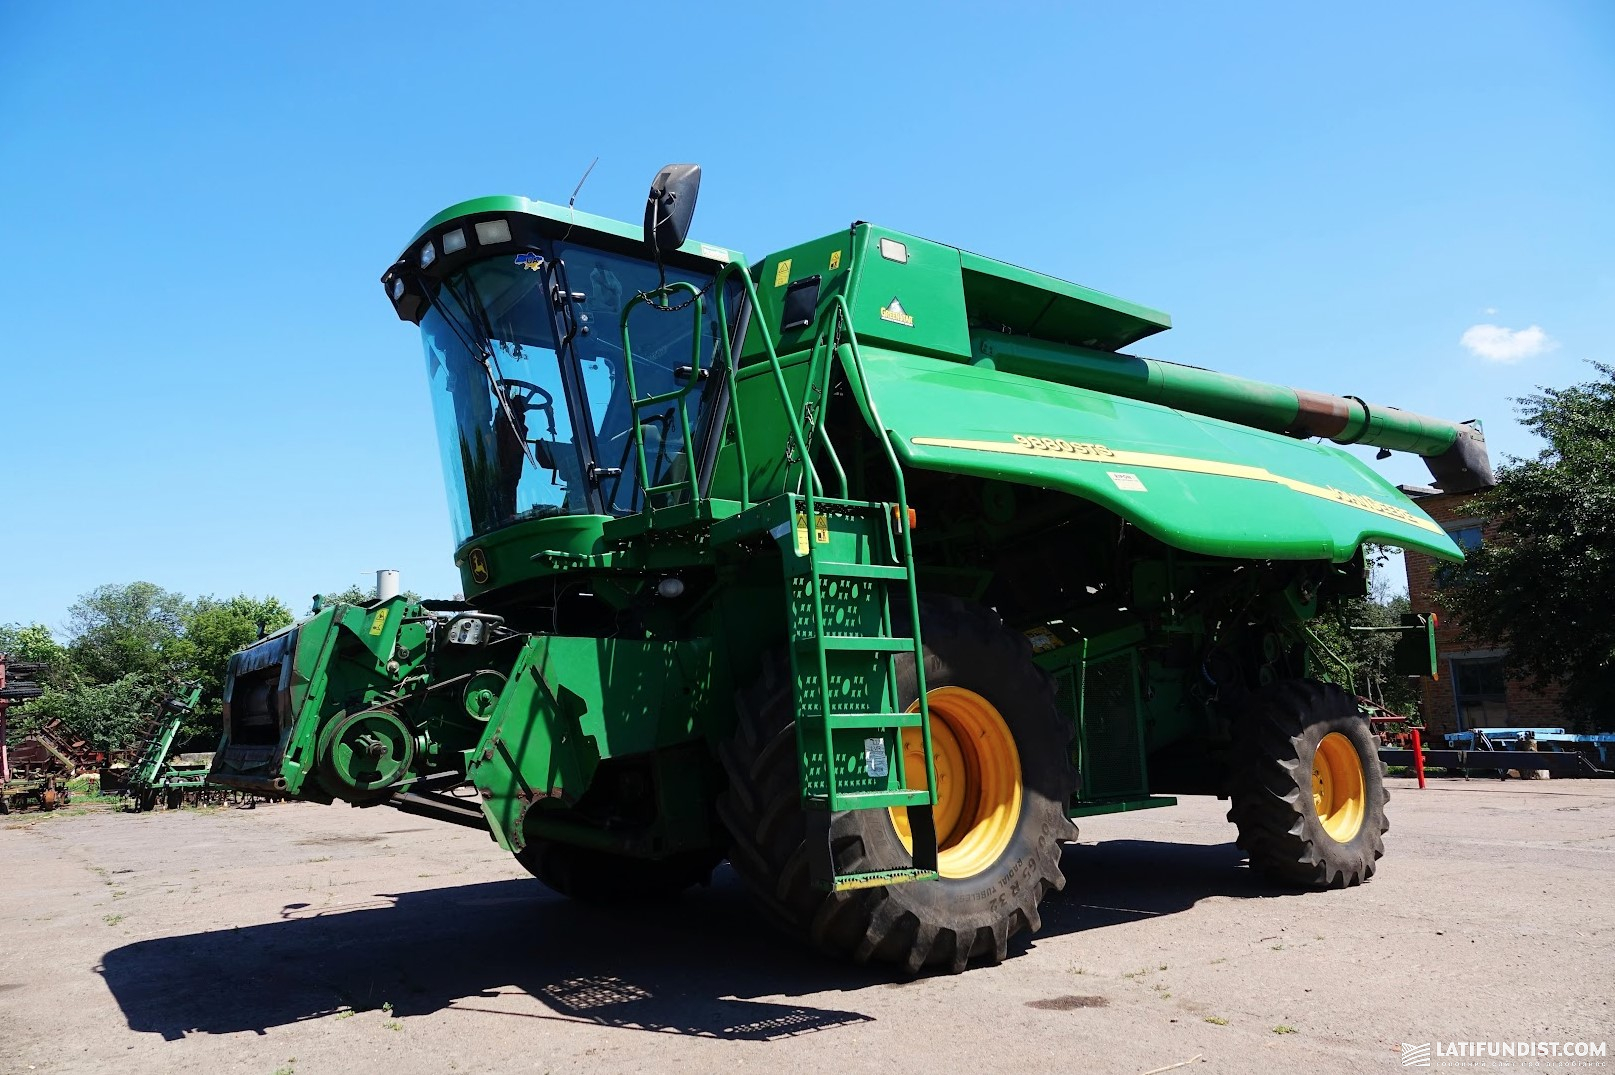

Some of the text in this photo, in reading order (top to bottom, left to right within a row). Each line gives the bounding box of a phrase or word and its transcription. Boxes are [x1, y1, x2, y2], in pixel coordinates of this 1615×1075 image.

[1013, 434, 1115, 457] 9880STS
[997, 857, 1023, 887] RADIAL
[1009, 881, 1021, 897] R
[988, 892, 1008, 913] 32
